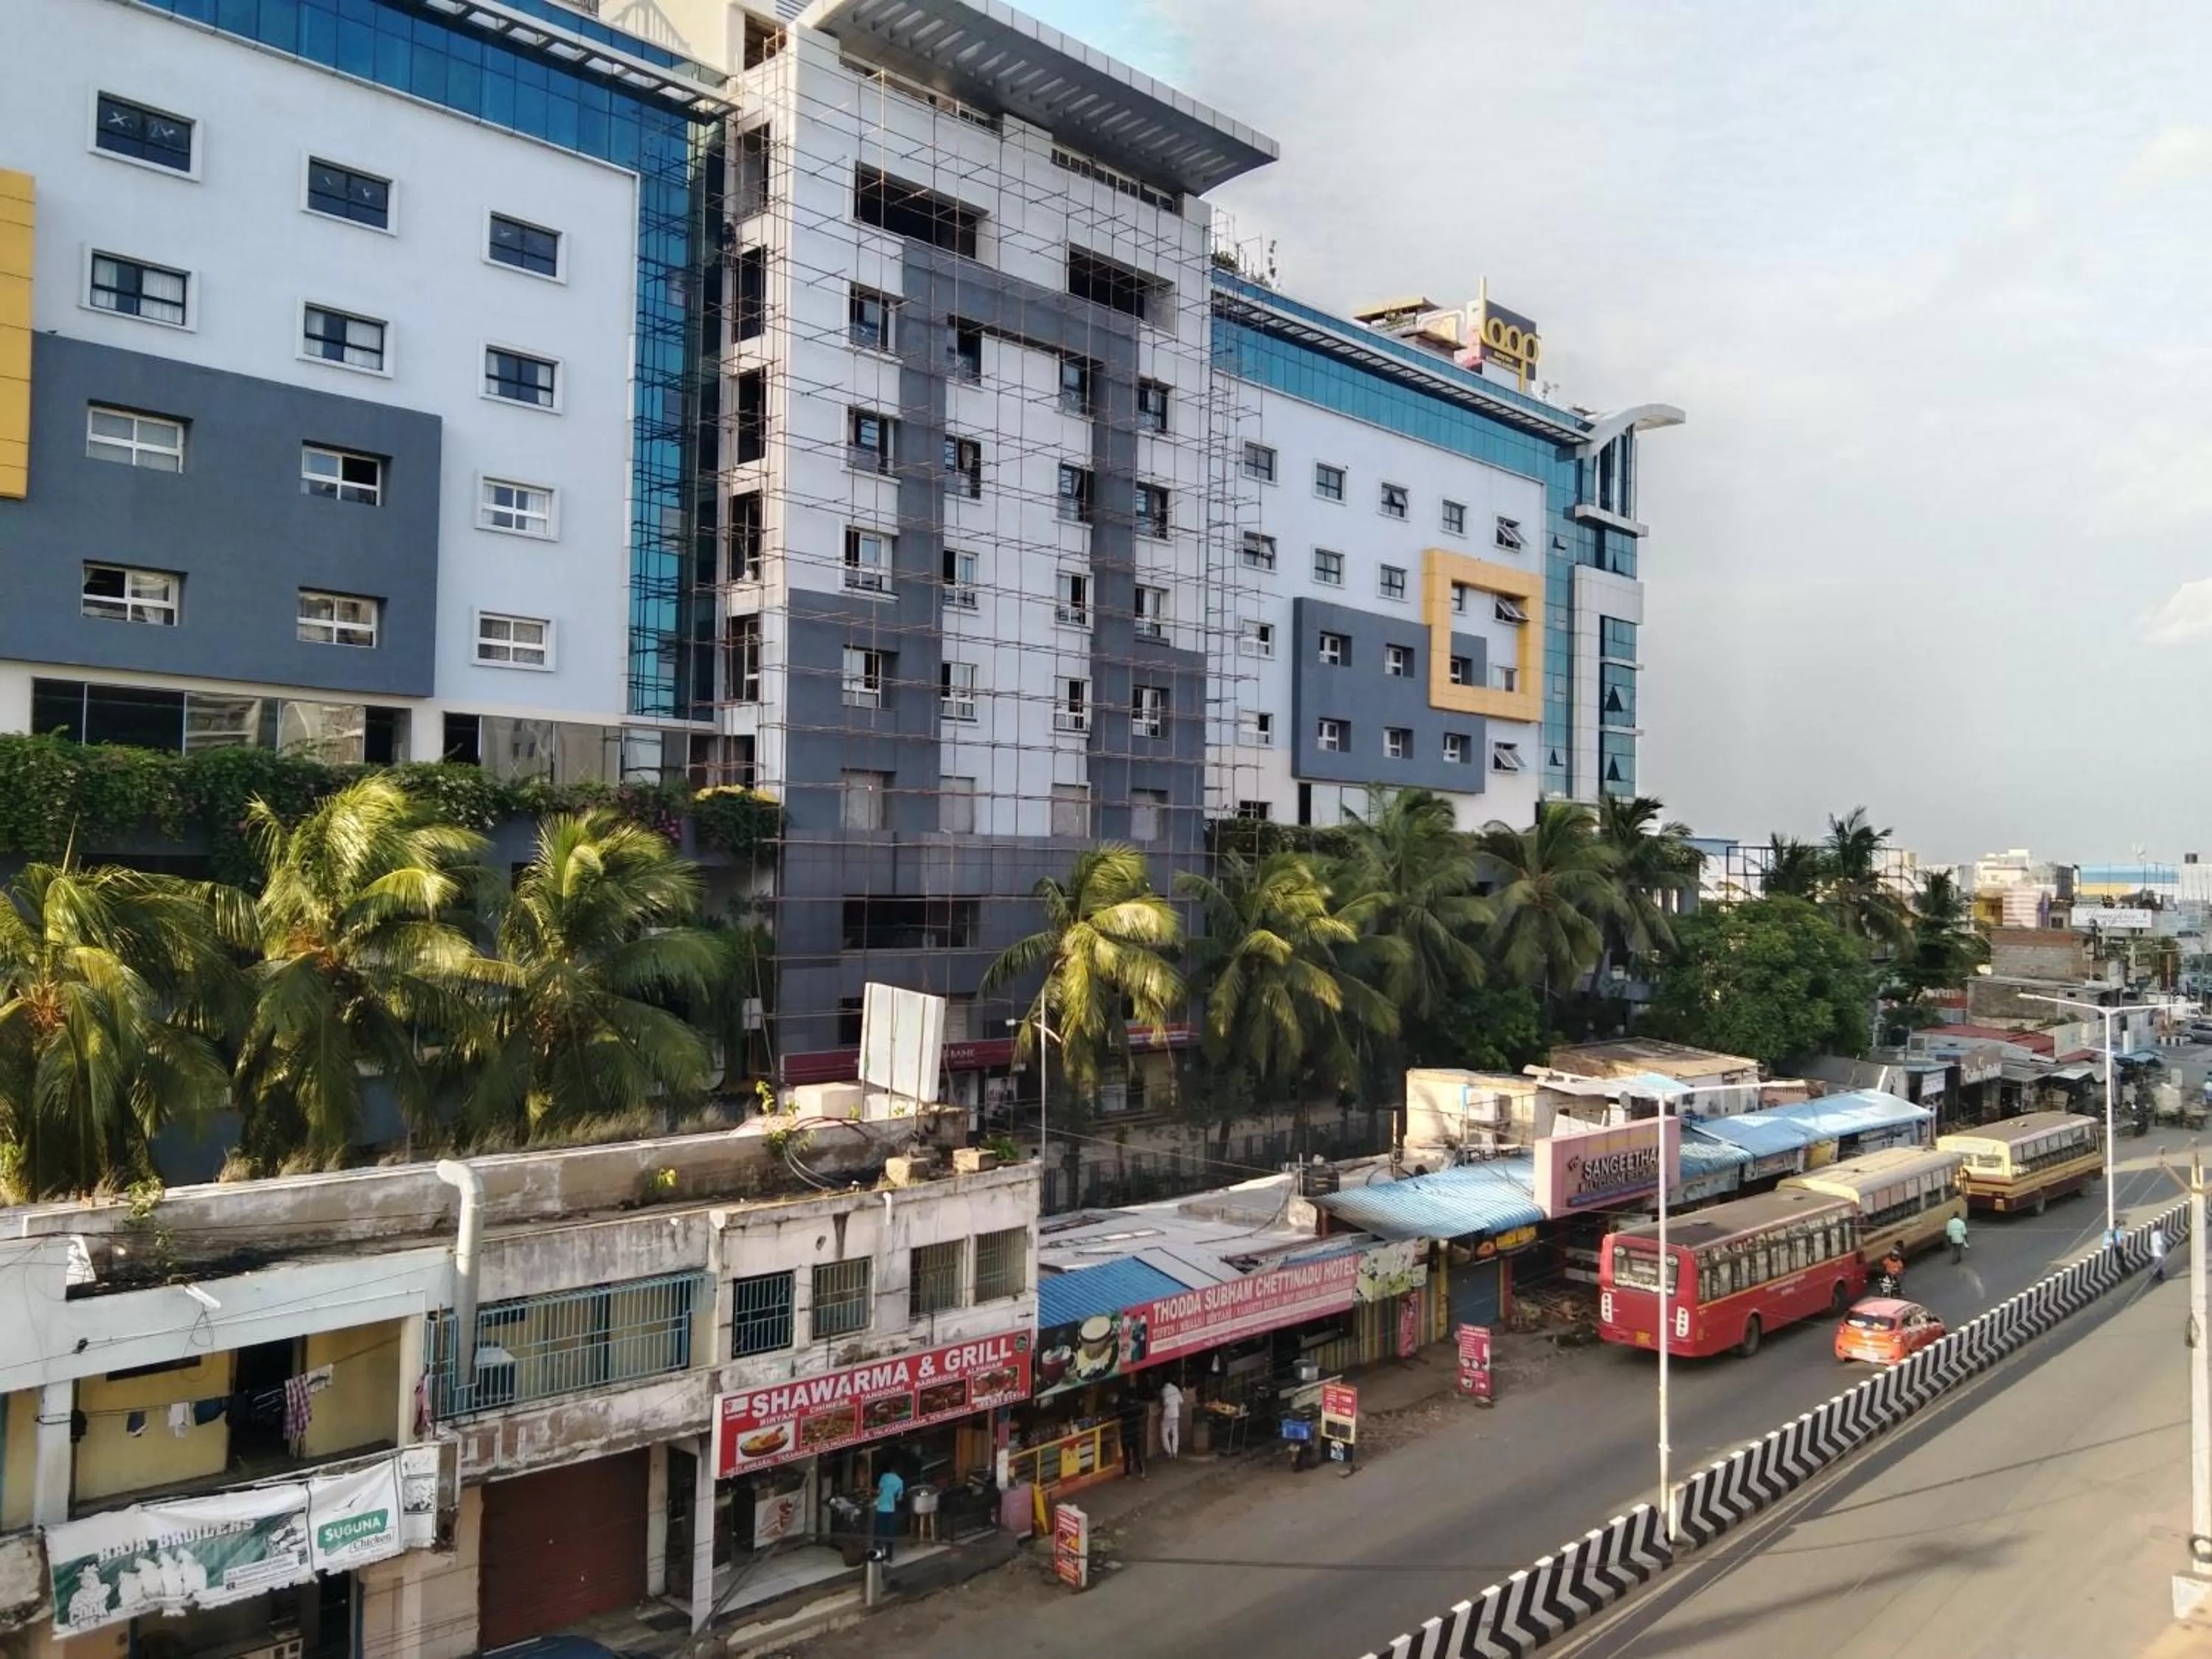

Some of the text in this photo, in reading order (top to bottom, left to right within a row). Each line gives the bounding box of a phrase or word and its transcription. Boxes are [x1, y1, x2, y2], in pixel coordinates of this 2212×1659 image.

[1152, 1293, 1202, 1324] THODDA
[1205, 1279, 1253, 1310] SUBHAM
[1256, 1264, 1322, 1298] CHETTINADU
[1324, 1255, 1356, 1281] HOTEL
[751, 1361, 910, 1418] SHAWARMA
[918, 1354, 936, 1378] &
[944, 1338, 1012, 1372] GRILL
[324, 1516, 382, 1542] SUGUNA
[352, 1532, 393, 1551] Chicken
